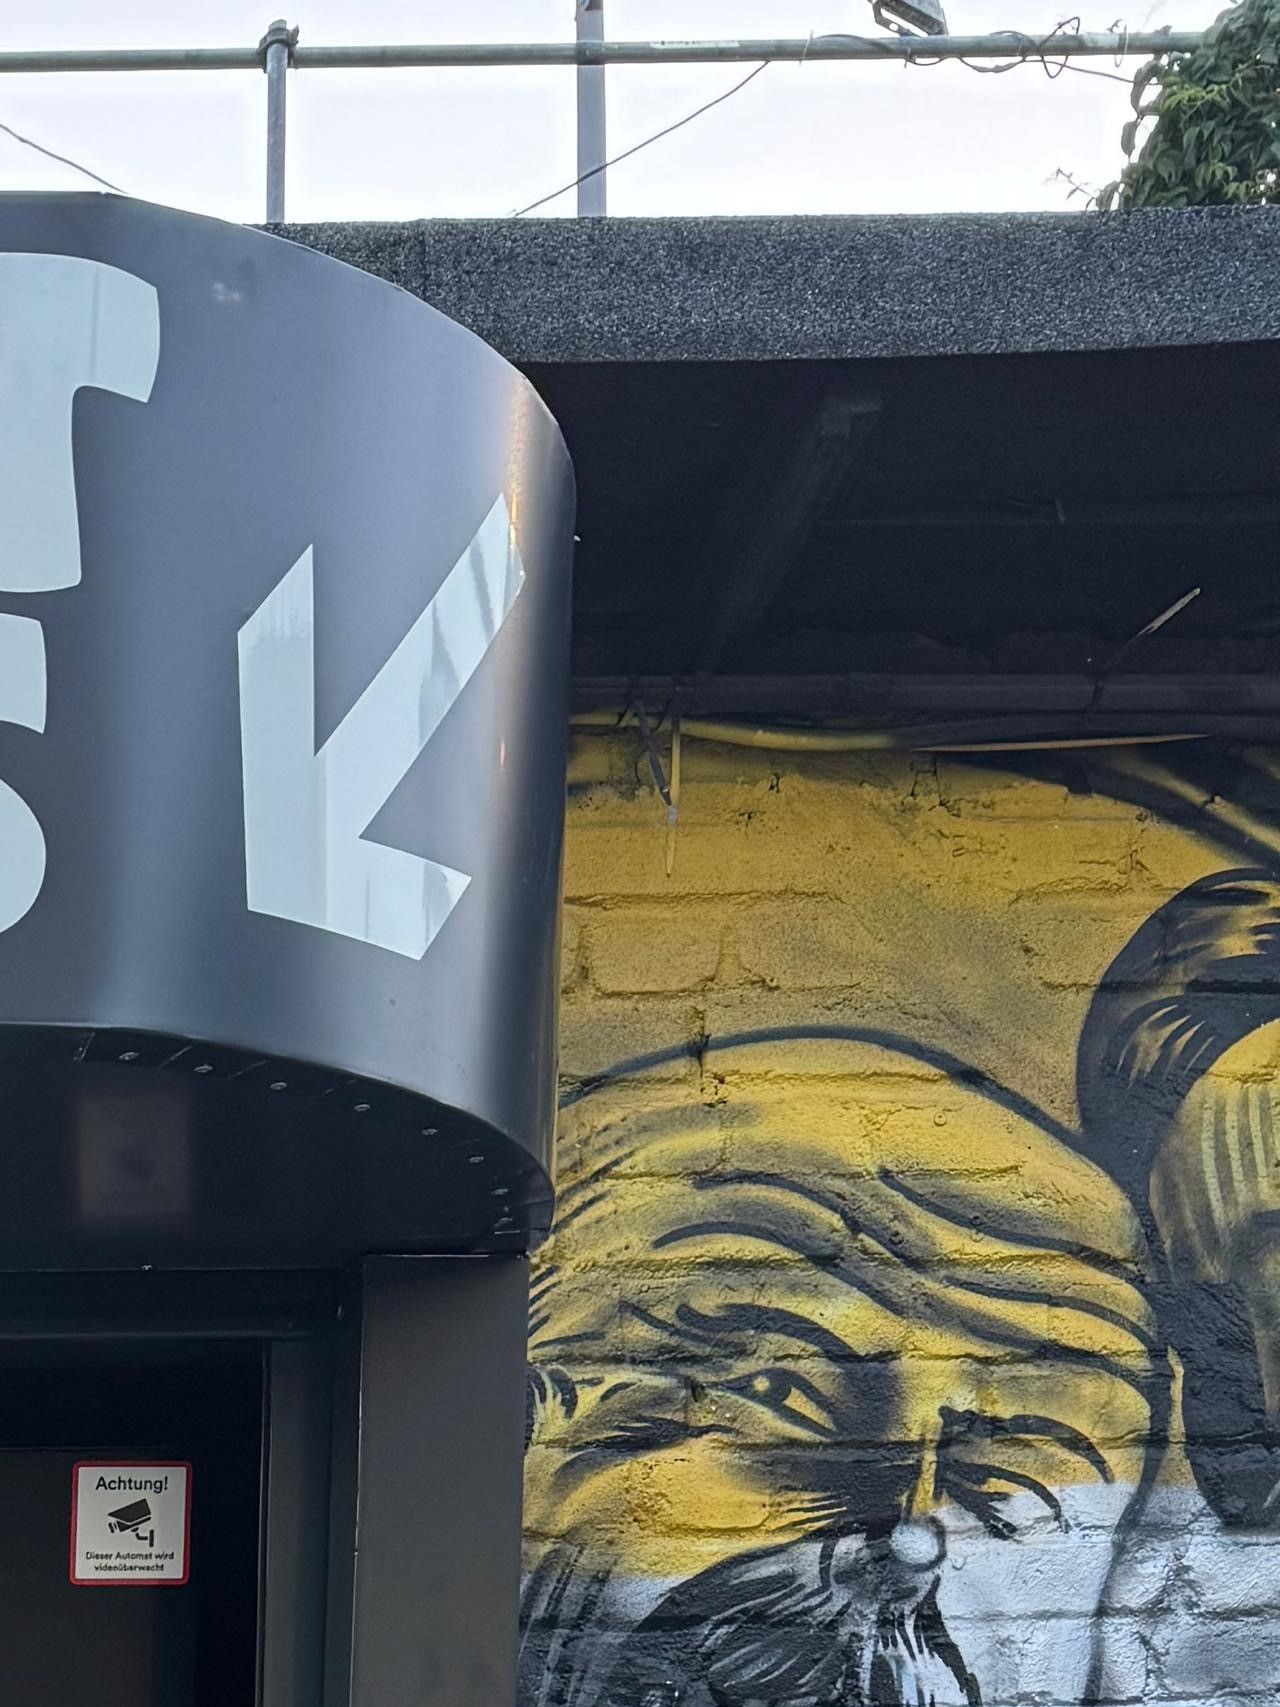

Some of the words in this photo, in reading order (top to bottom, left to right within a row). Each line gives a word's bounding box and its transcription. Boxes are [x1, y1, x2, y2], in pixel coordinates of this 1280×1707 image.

[96, 1476, 168, 1494] Achtung!
[86, 1551, 113, 1560] Dieser
[116, 1551, 153, 1560] Automat
[155, 1551, 174, 1560] wird
[94, 1563, 164, 1572] videoüberwacht
